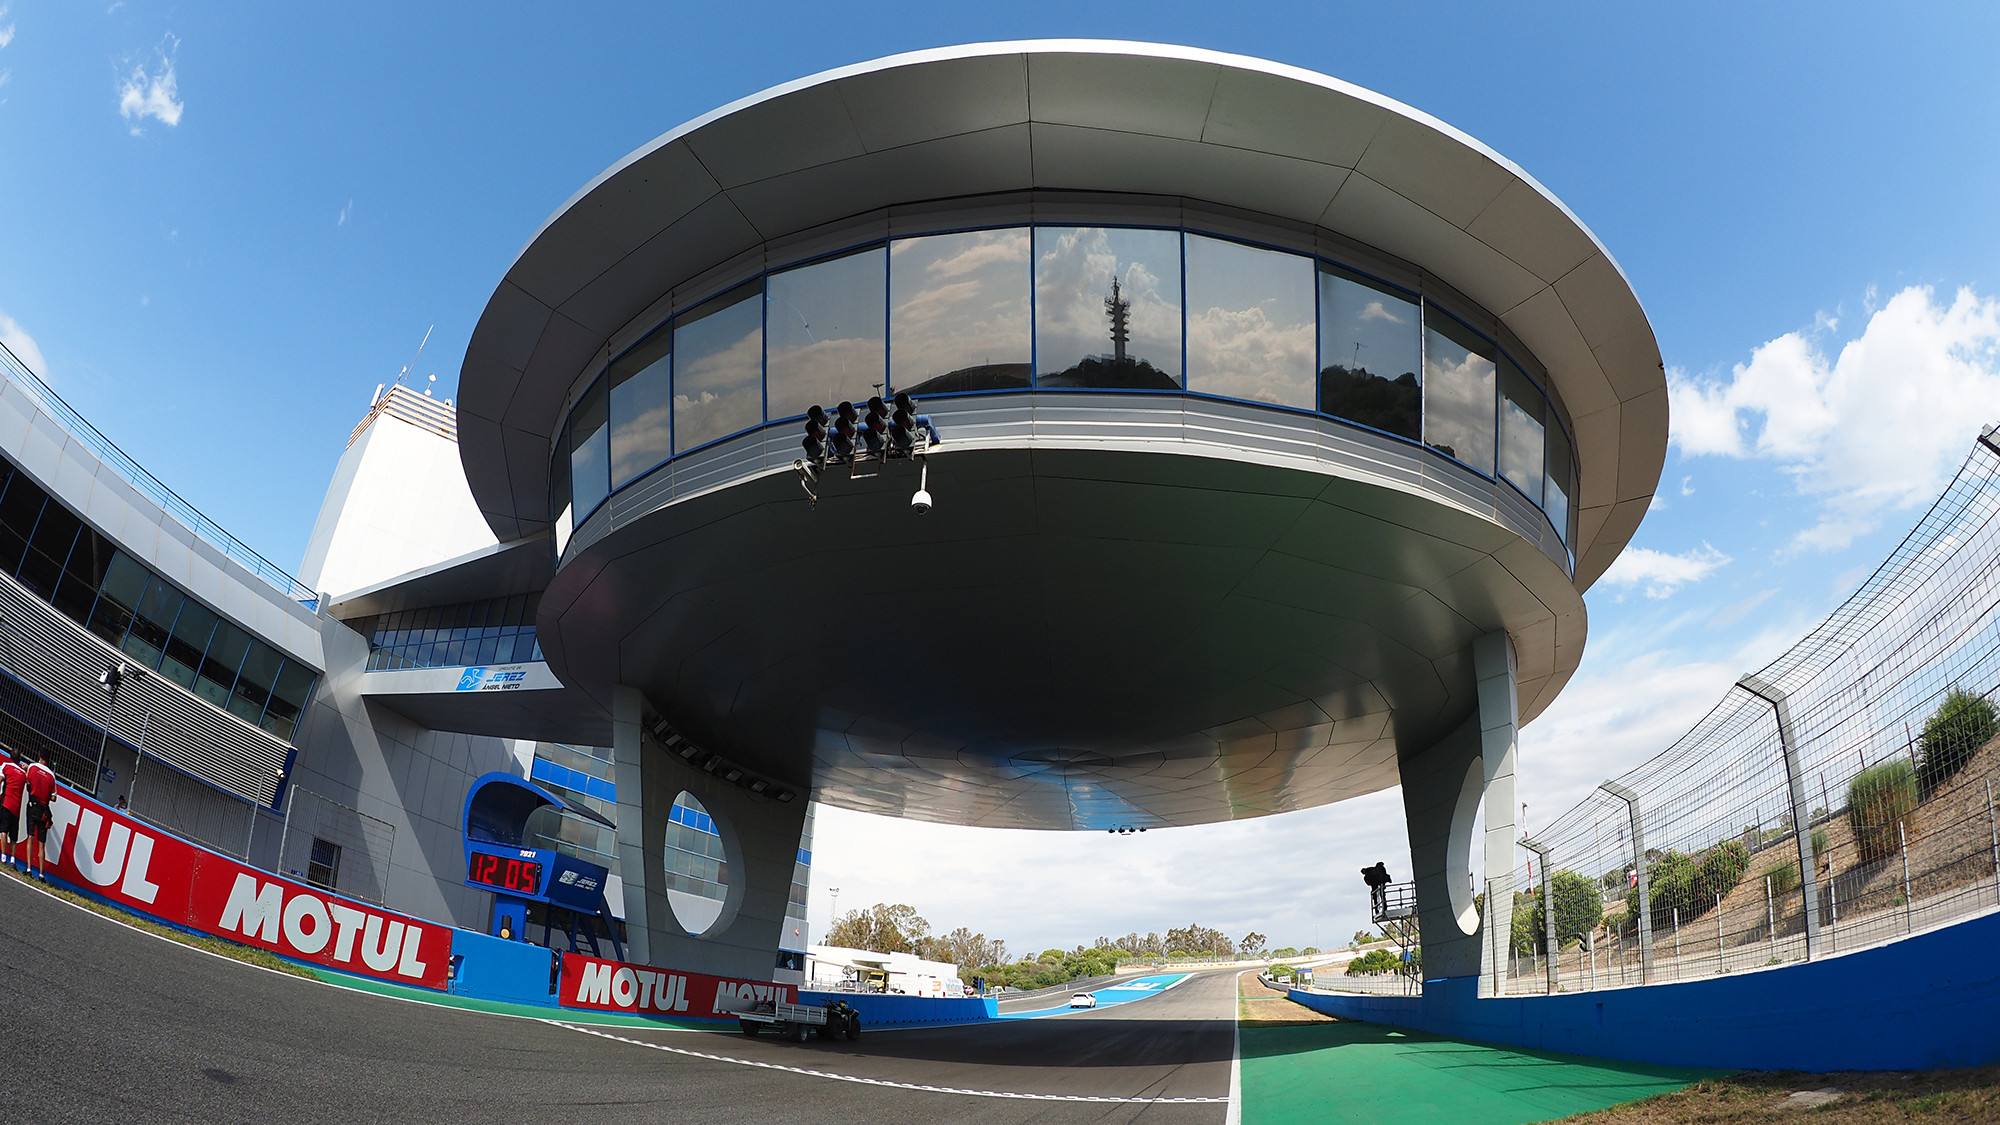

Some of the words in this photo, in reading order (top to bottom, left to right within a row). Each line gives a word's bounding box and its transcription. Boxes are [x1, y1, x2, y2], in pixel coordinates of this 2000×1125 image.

[486, 671, 527, 682] JEREZ
[0, 782, 160, 905] TUL
[519, 850, 537, 858] 2021
[476, 854, 498, 885] 12
[505, 859, 536, 893] 05
[218, 872, 427, 979] MOTUL
[576, 961, 690, 1012] MOTUL
